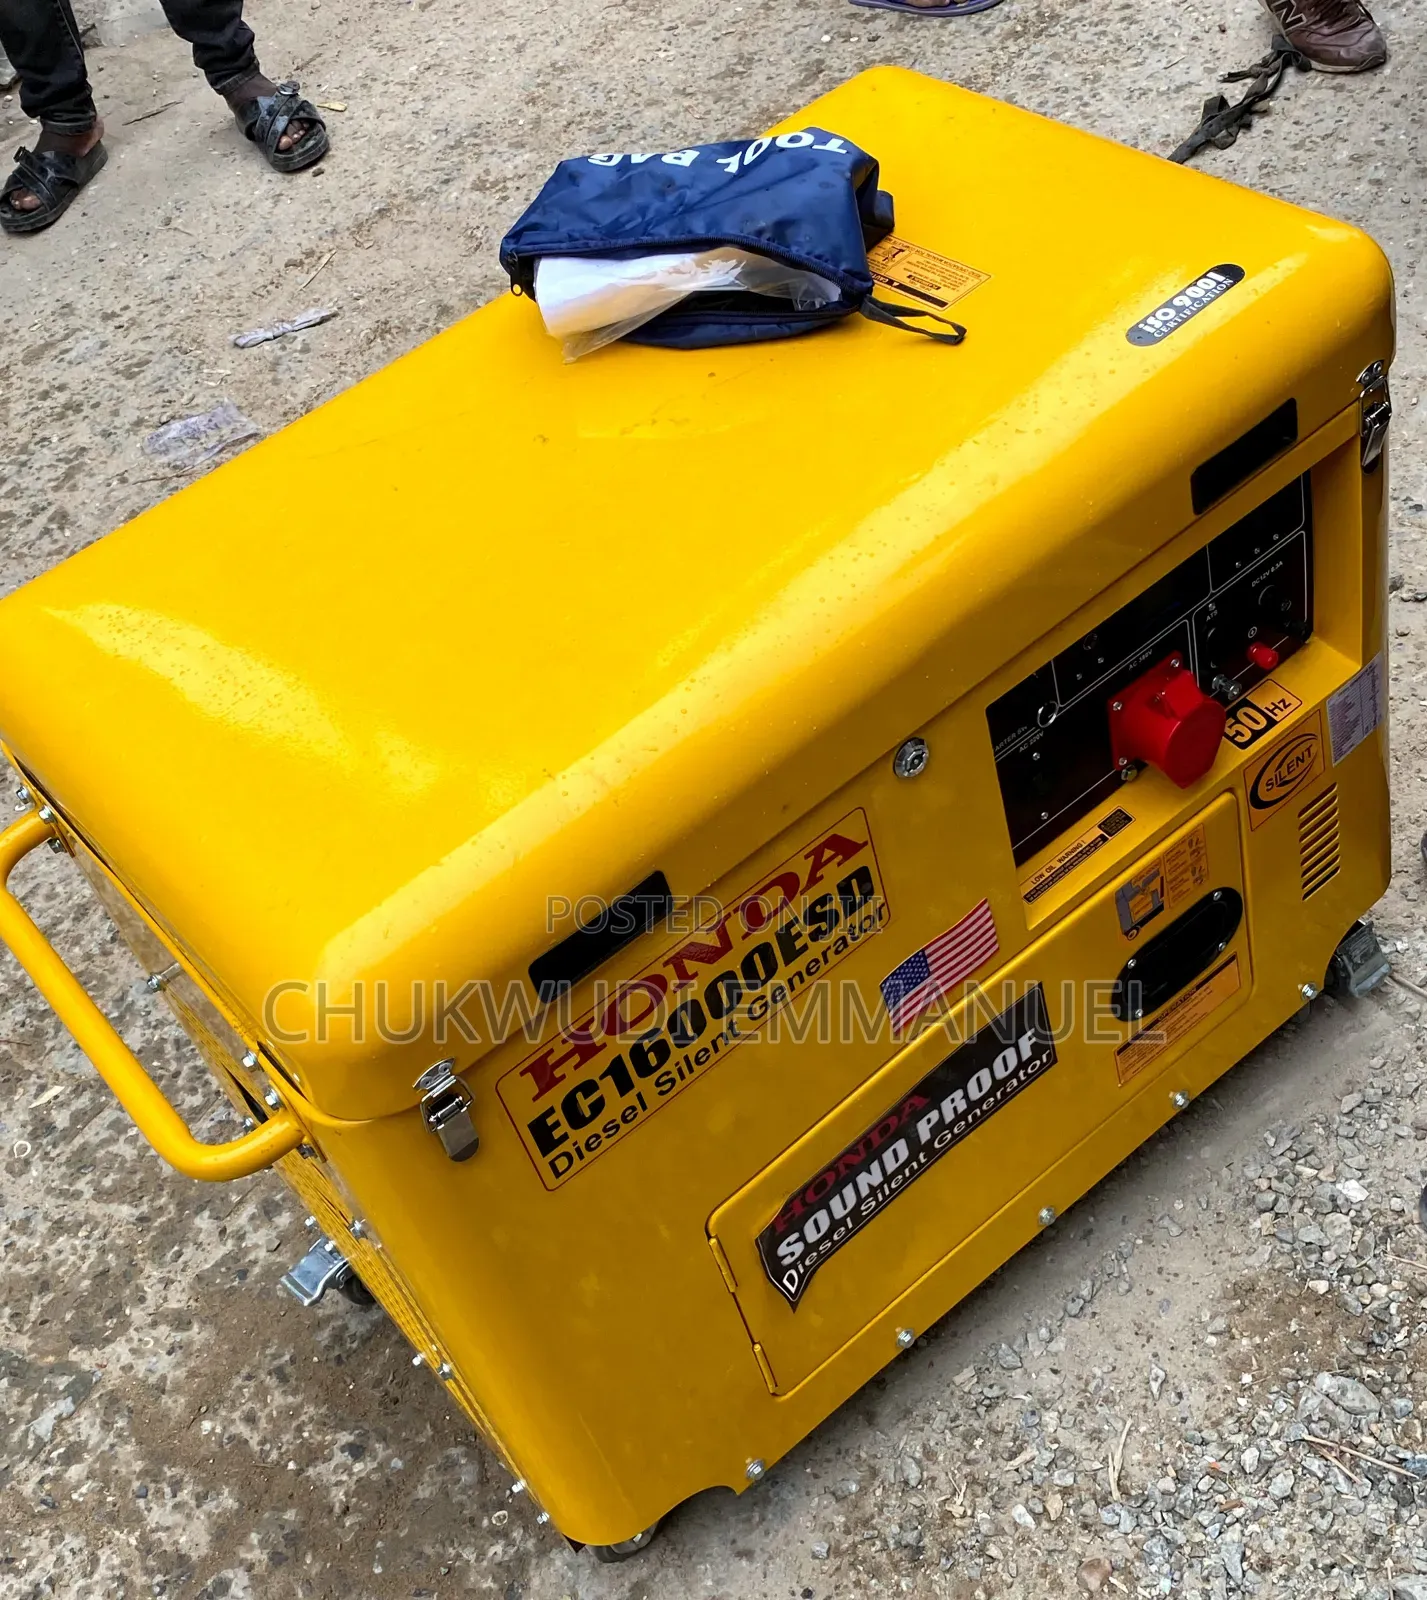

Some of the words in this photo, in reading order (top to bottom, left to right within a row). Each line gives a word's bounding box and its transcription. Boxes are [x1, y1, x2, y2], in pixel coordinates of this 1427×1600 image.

[716, 131, 848, 174] TOOL
[1153, 278, 1234, 338] CERTIFICATION
[1172, 271, 1226, 307] 9001
[1206, 609, 1218, 622] ATS
[1128, 660, 1138, 671] AC
[1138, 648, 1153, 663] 380V
[1018, 742, 1029, 753] AC
[1029, 730, 1044, 746] 220V
[1225, 706, 1267, 743] 50
[1264, 698, 1292, 717] Hz
[1265, 744, 1313, 792] SILENT
[1030, 872, 1046, 885] LOW
[1045, 864, 1057, 874] OIL
[519, 833, 869, 1103] HONDA
[527, 865, 876, 1159] EC16000ESD
[548, 1096, 649, 1180] Diesel
[654, 1019, 741, 1097] Silent
[746, 902, 889, 1022] Generator
[773, 1092, 931, 1236] HONDA
[777, 1138, 910, 1267] SOUND
[916, 1027, 1038, 1145] PROOF
[782, 1217, 853, 1295] Diesel
[861, 1151, 929, 1217] Silent
[933, 1049, 1052, 1150] Generator
